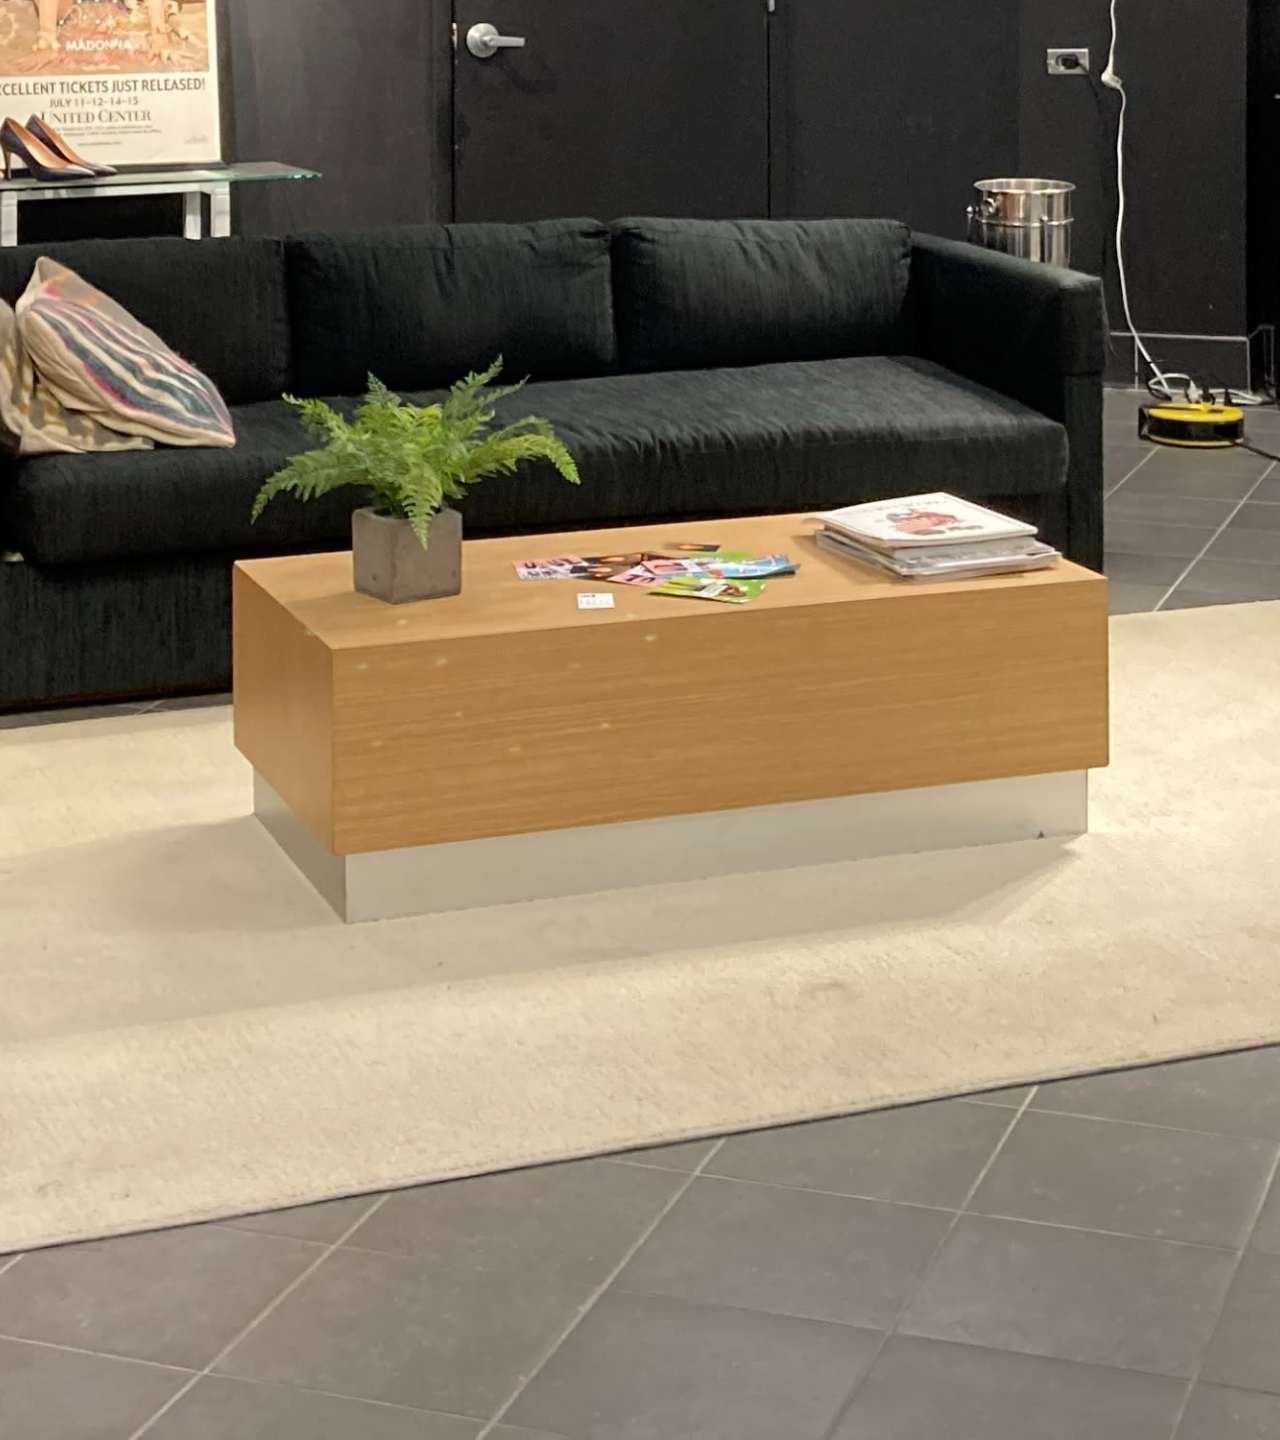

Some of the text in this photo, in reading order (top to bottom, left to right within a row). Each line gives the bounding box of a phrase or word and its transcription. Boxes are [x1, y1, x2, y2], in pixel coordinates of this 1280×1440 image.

[59, 79, 109, 94] TICKETS
[111, 78, 140, 93] JUST
[142, 77, 206, 92] RELEASED!
[49, 98, 72, 108] JULY
[98, 108, 151, 122] CENTER
